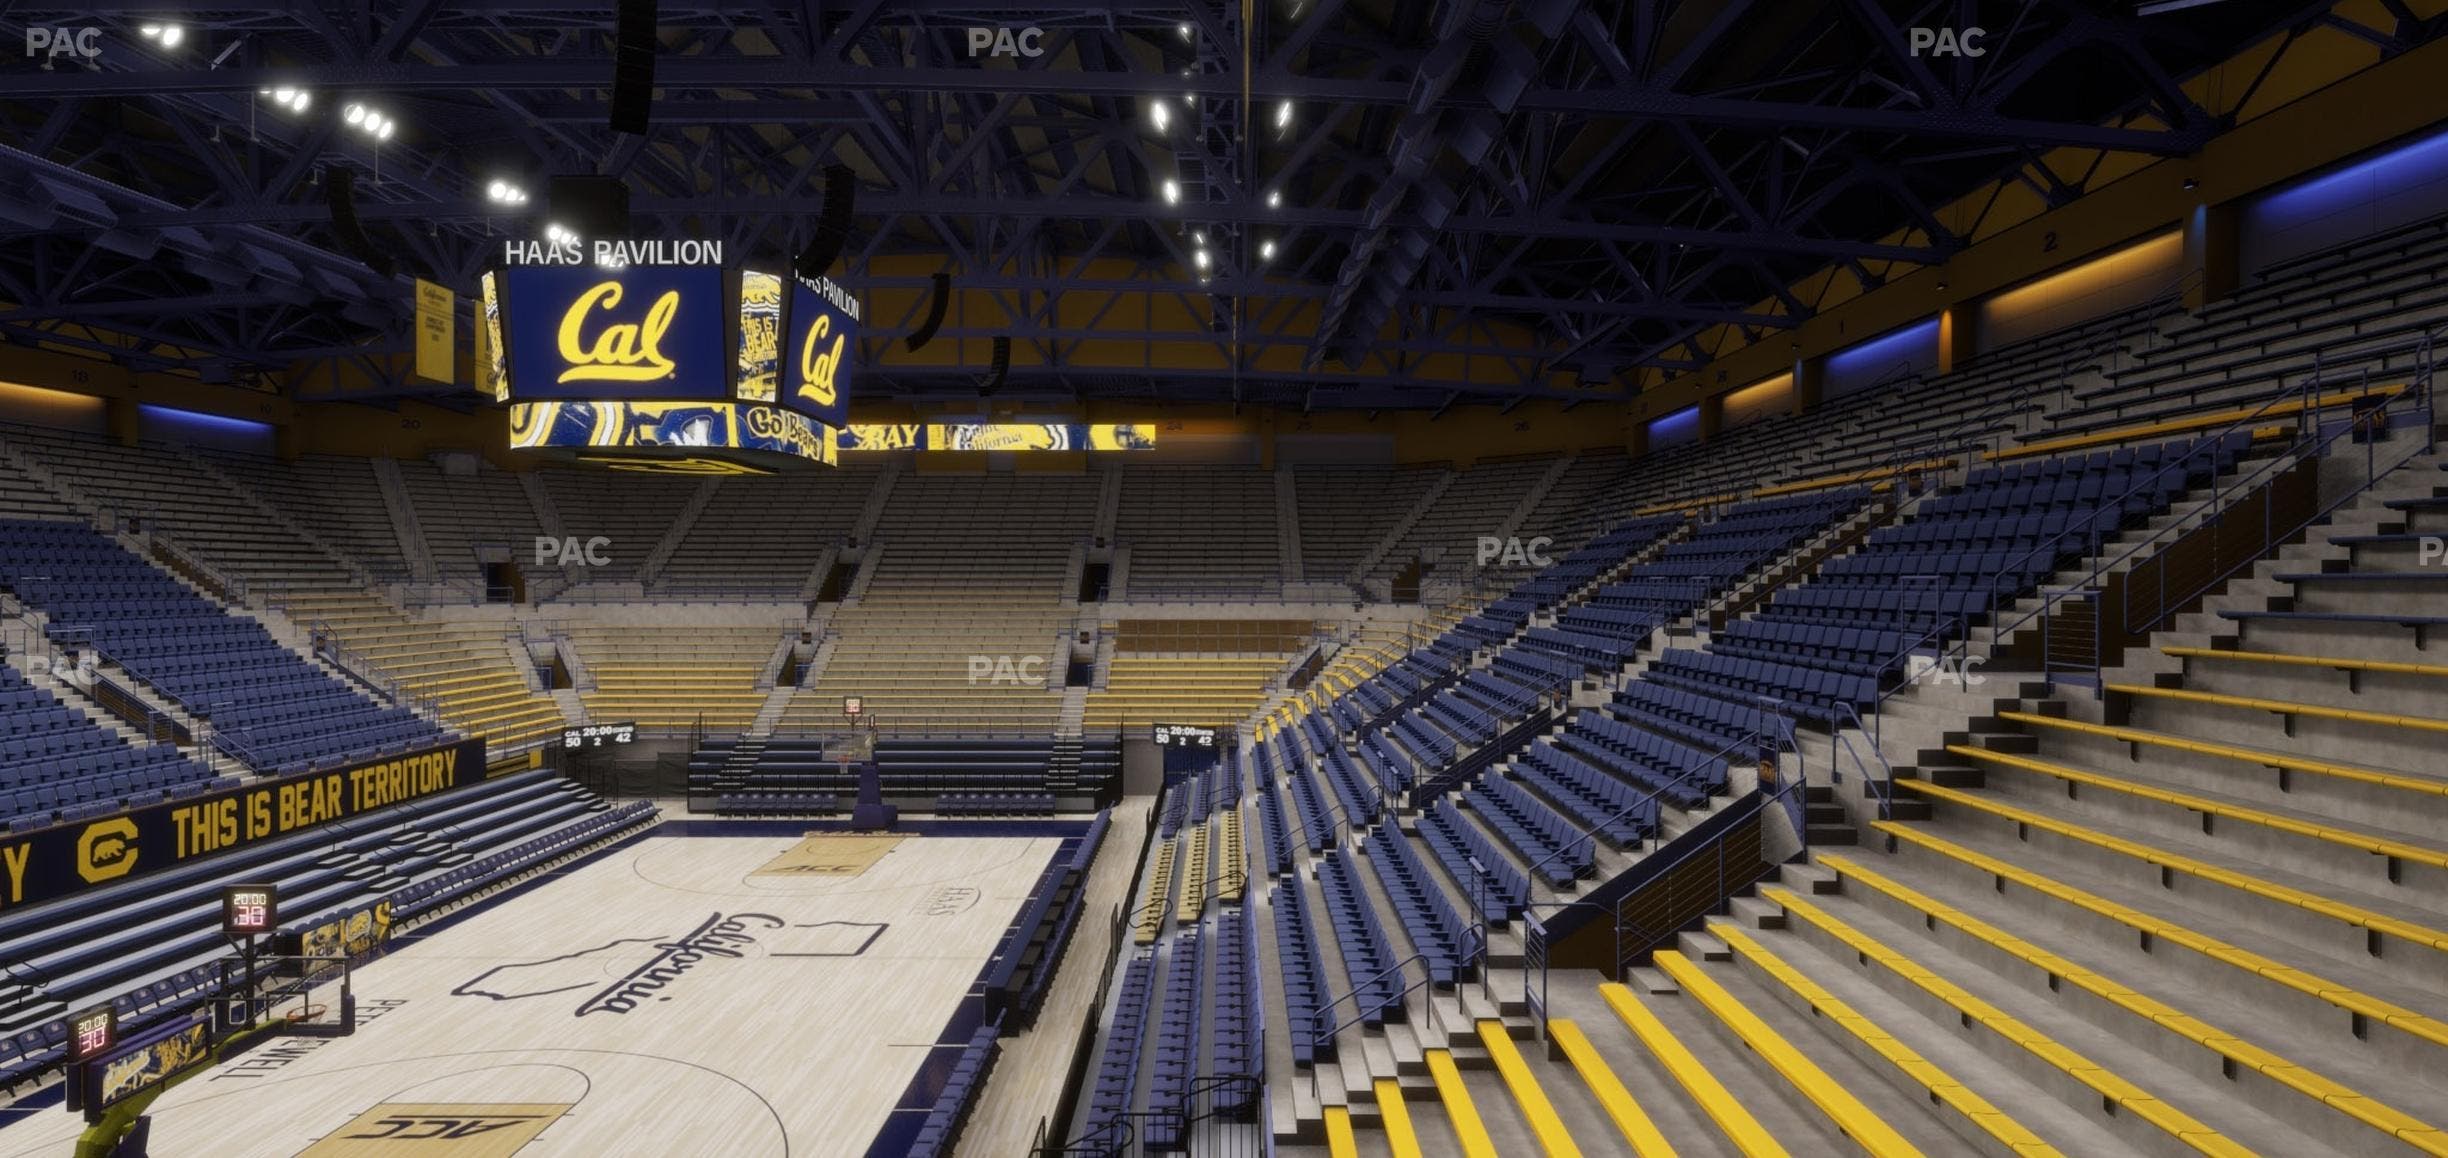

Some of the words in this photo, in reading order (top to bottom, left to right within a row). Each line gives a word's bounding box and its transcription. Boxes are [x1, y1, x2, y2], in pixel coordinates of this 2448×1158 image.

[505, 240, 583, 265] HAAS
[594, 240, 722, 265] PAVILION
[2043, 231, 2058, 253] 2
[823, 276, 860, 322] PAVILION
[557, 281, 680, 384] Cal
[798, 314, 845, 406] Cal
[401, 418, 422, 431] 20
[565, 737, 581, 748] 50
[594, 738, 602, 746] 2
[615, 733, 631, 743] 42
[583, 726, 612, 736] 20:00
[1156, 734, 1169, 743] 50
[1179, 737, 1186, 746] 2
[1198, 736, 1212, 746] 42
[1170, 726, 1195, 736] 20:00
[172, 798, 238, 858] THIS
[246, 791, 271, 839] IS
[278, 775, 344, 831] BEAR
[349, 749, 458, 809] TERRITORY
[577, 911, 786, 1017] California
[78, 1014, 108, 1034] 20:00
[79, 1027, 105, 1055] 30
[340, 1119, 528, 1140] ACC
